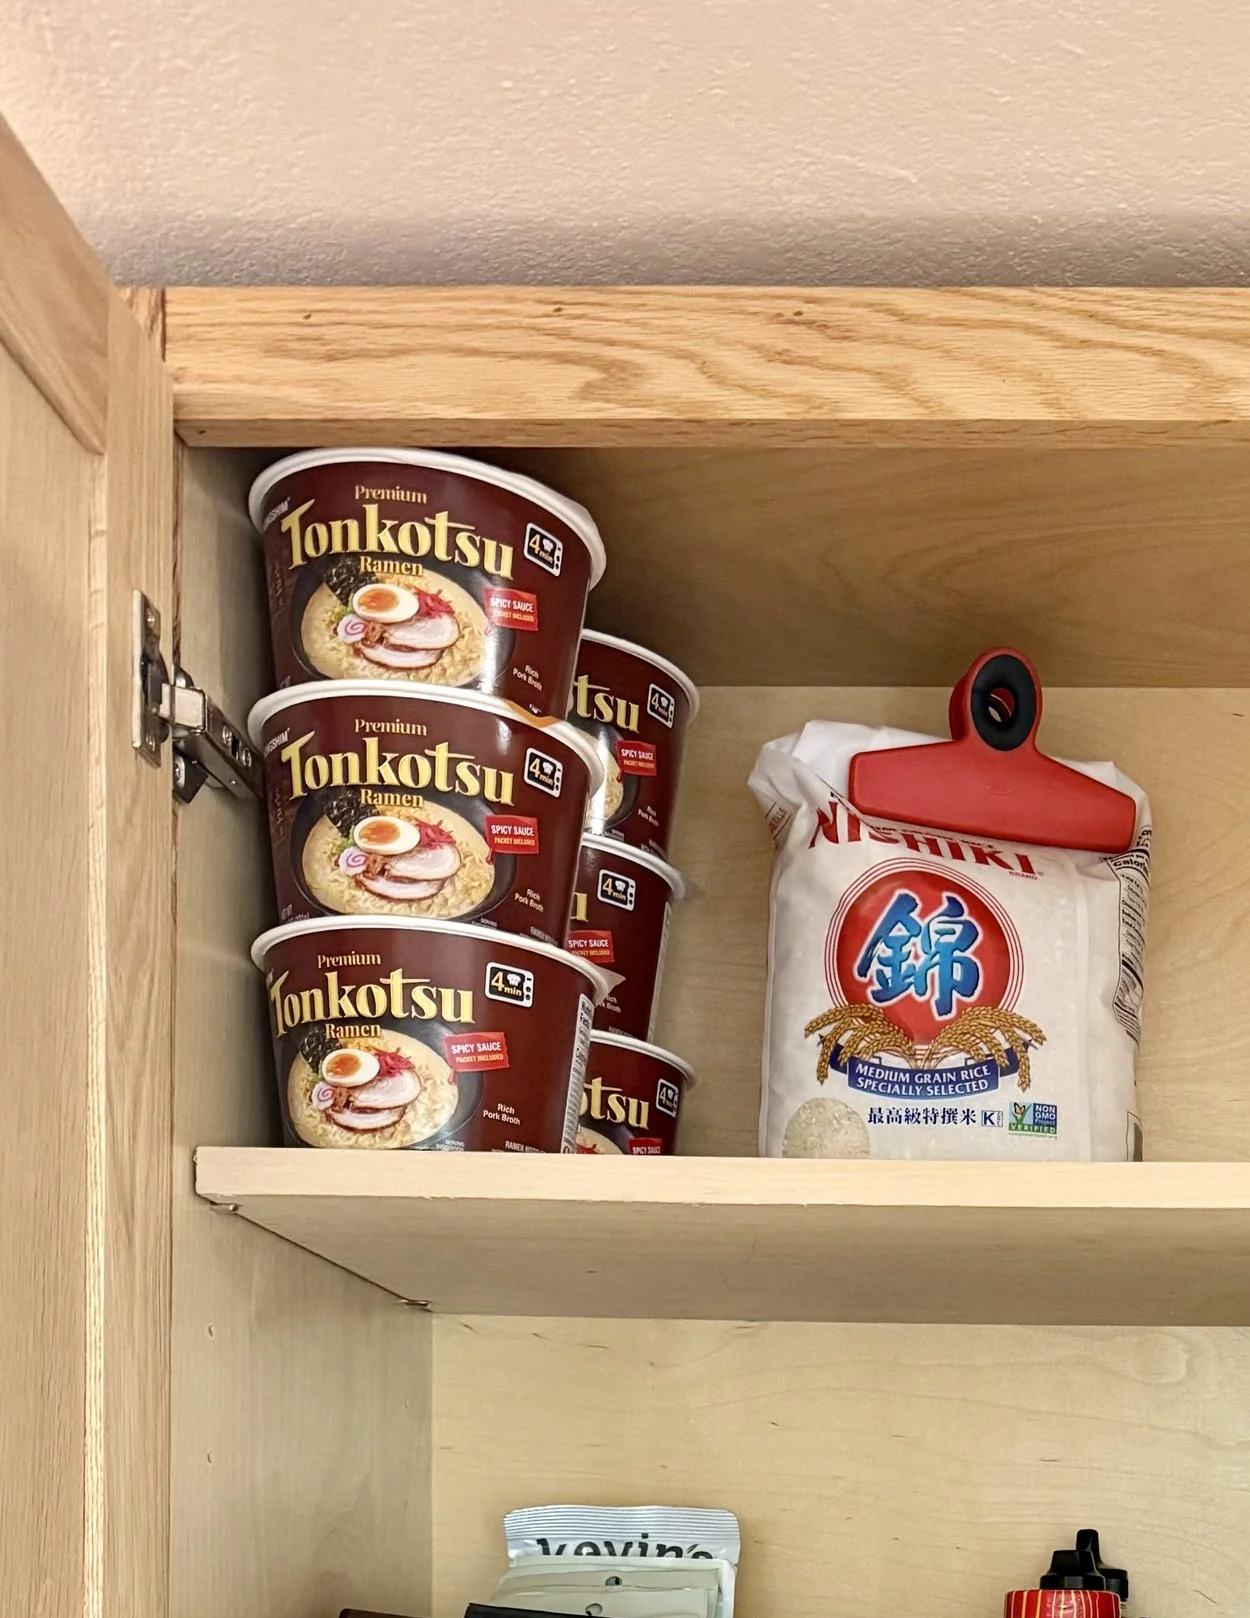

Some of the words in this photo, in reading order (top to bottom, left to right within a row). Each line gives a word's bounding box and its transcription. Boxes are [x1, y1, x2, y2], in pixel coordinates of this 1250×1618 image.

[355, 485, 427, 504] Premium
[281, 499, 514, 580] Tonkotsu
[529, 532, 540, 553] 4
[539, 550, 554, 565] min
[360, 555, 424, 576] Ramen
[512, 598, 534, 613] SAUCE
[355, 718, 427, 737] Premium
[281, 730, 514, 806] Tonkotsu
[528, 758, 540, 778] 4
[539, 773, 554, 787] min
[360, 789, 424, 808] Ramen
[490, 824, 510, 838] SPICY
[512, 825, 534, 839] SAUCE
[526, 888, 541, 901] Rich
[602, 878, 613, 895] 4
[514, 892, 529, 908] Pork
[528, 898, 544, 913] Broth
[568, 940, 587, 948] SPICY
[589, 940, 609, 948] SAUCE
[317, 950, 381, 969] Premium
[857, 892, 980, 1018] 錦
[490, 971, 505, 992] 4
[503, 984, 523, 998] min
[270, 969, 476, 1038] Tonkotsu
[325, 1022, 381, 1039] Ramen
[451, 1043, 475, 1055] SPICY
[477, 1041, 502, 1052] SAUCE
[456, 1054, 476, 1064] PACKET
[477, 1052, 504, 1062] INCLUDED
[856, 1063, 910, 1083] MEDIUM
[914, 1070, 956, 1084] GRAIN
[961, 1065, 991, 1081] RICE
[856, 1078, 924, 1096] SPECIALLY
[926, 1079, 989, 1096] SELECTED
[483, 1109, 500, 1121] Pork
[501, 1113, 521, 1126] Broth
[498, 1103, 515, 1114] Rich
[1035, 1105, 1055, 1113] NON
[1035, 1112, 1056, 1120] GMO
[1010, 1124, 1056, 1134] VERIFIED
